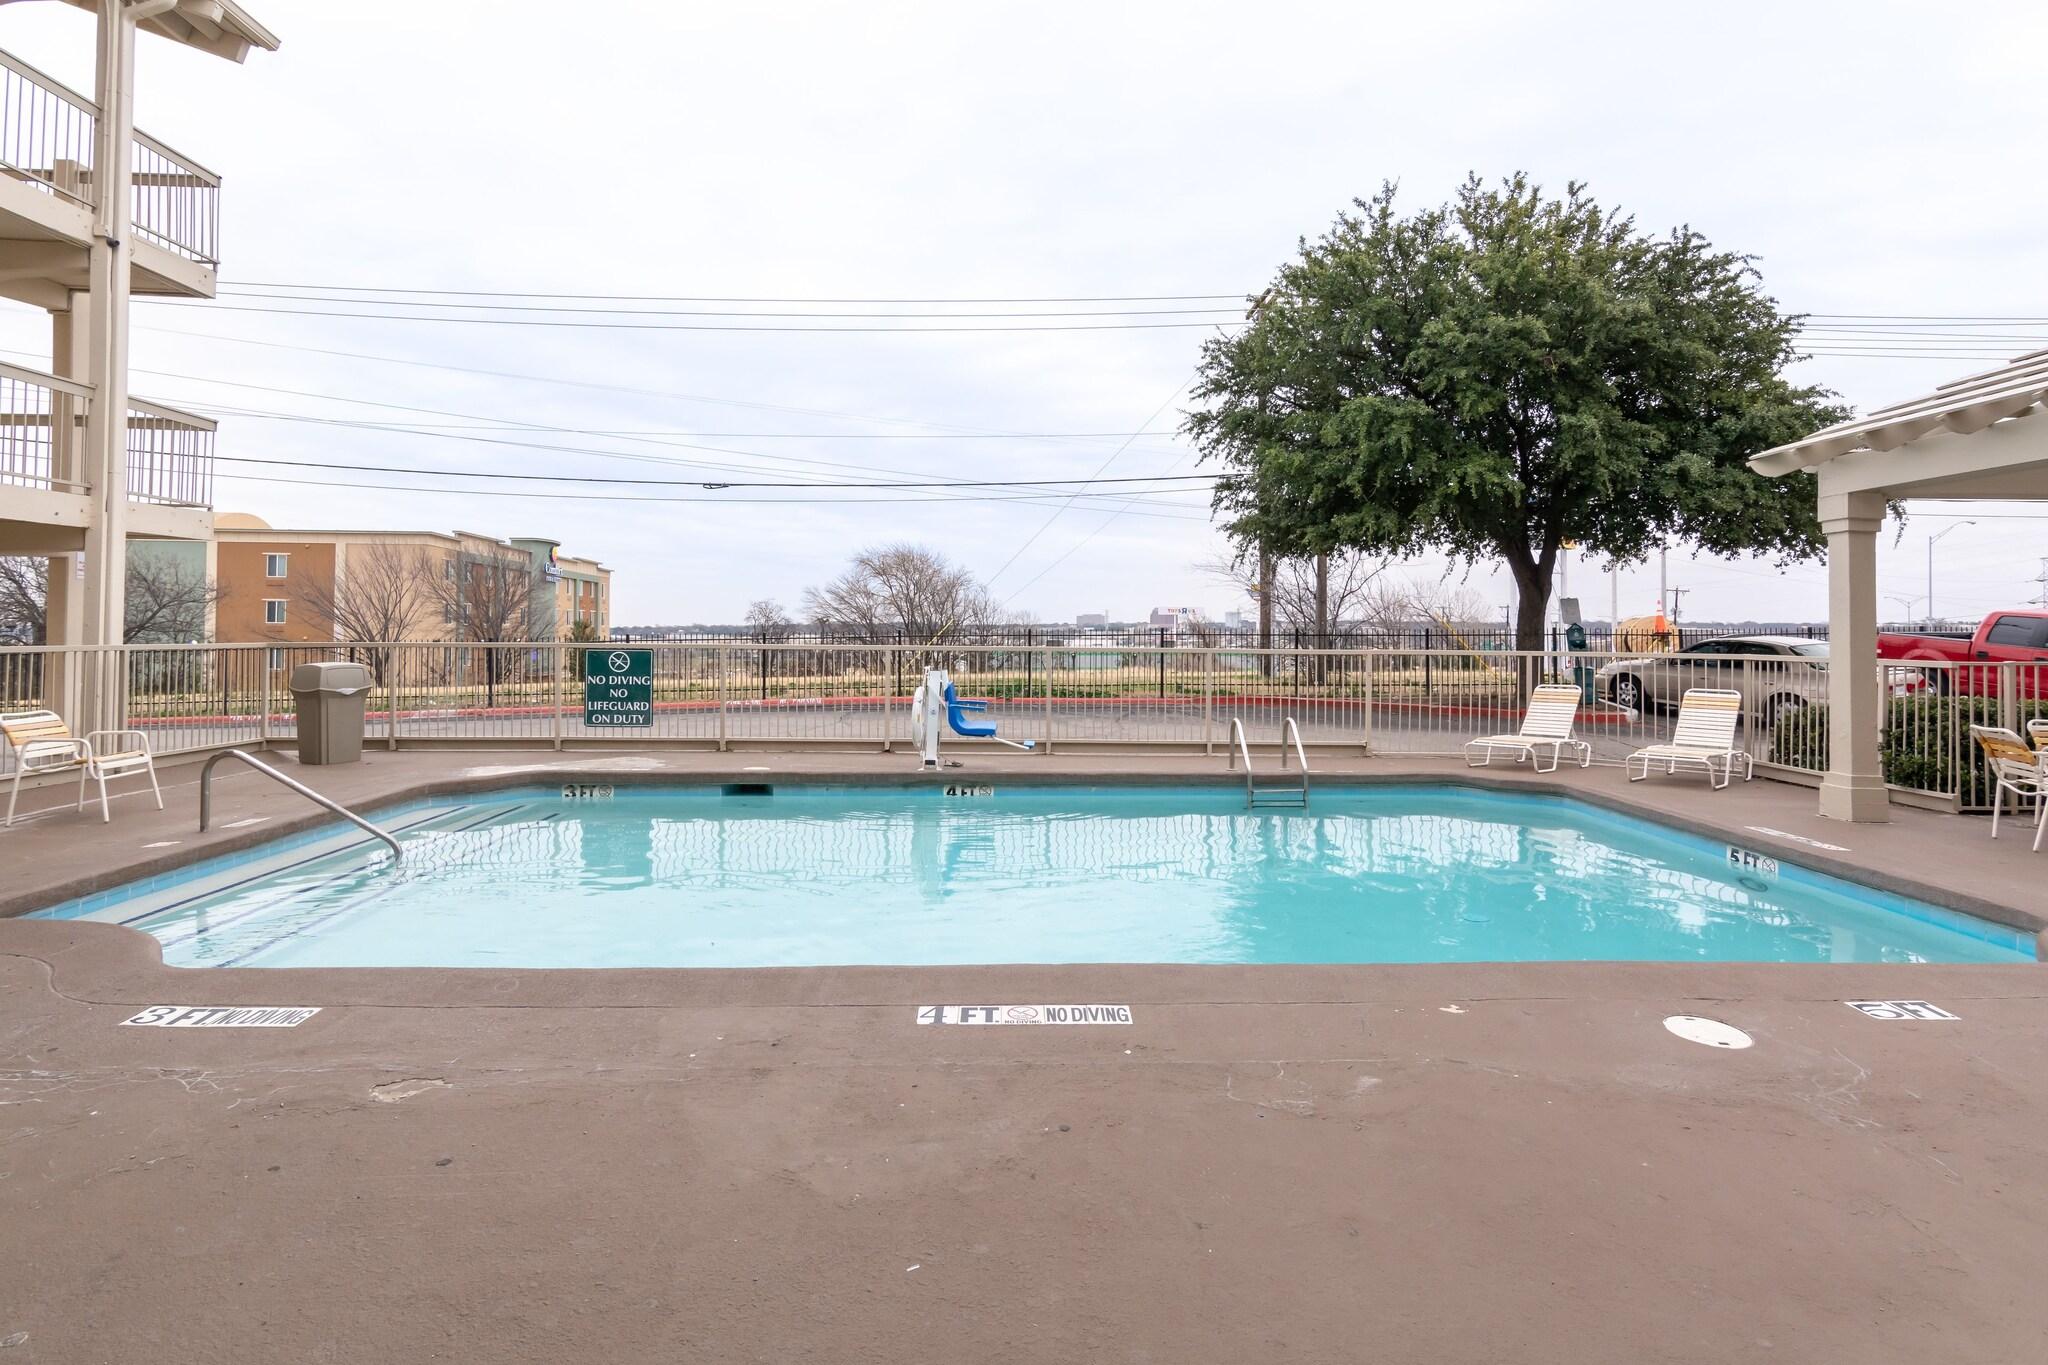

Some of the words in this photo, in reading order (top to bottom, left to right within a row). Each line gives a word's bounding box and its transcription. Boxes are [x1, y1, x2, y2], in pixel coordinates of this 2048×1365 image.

[587, 675, 606, 685] NO
[608, 675, 651, 686] DIVING
[609, 688, 628, 698] NO
[588, 701, 650, 711] LIFEGUARD
[592, 714, 611, 724] ON
[613, 714, 645, 724] DUTY
[564, 784, 577, 798] 3
[946, 785, 958, 796] 4
[1730, 847, 1740, 862] 5
[129, 1007, 177, 1024] 3
[236, 1009, 315, 1025] DIVING
[919, 1006, 948, 1024] 4
[1046, 1007, 1068, 1023] NO
[1071, 1007, 1130, 1023] DIVING
[1852, 1003, 1905, 1019] 5
